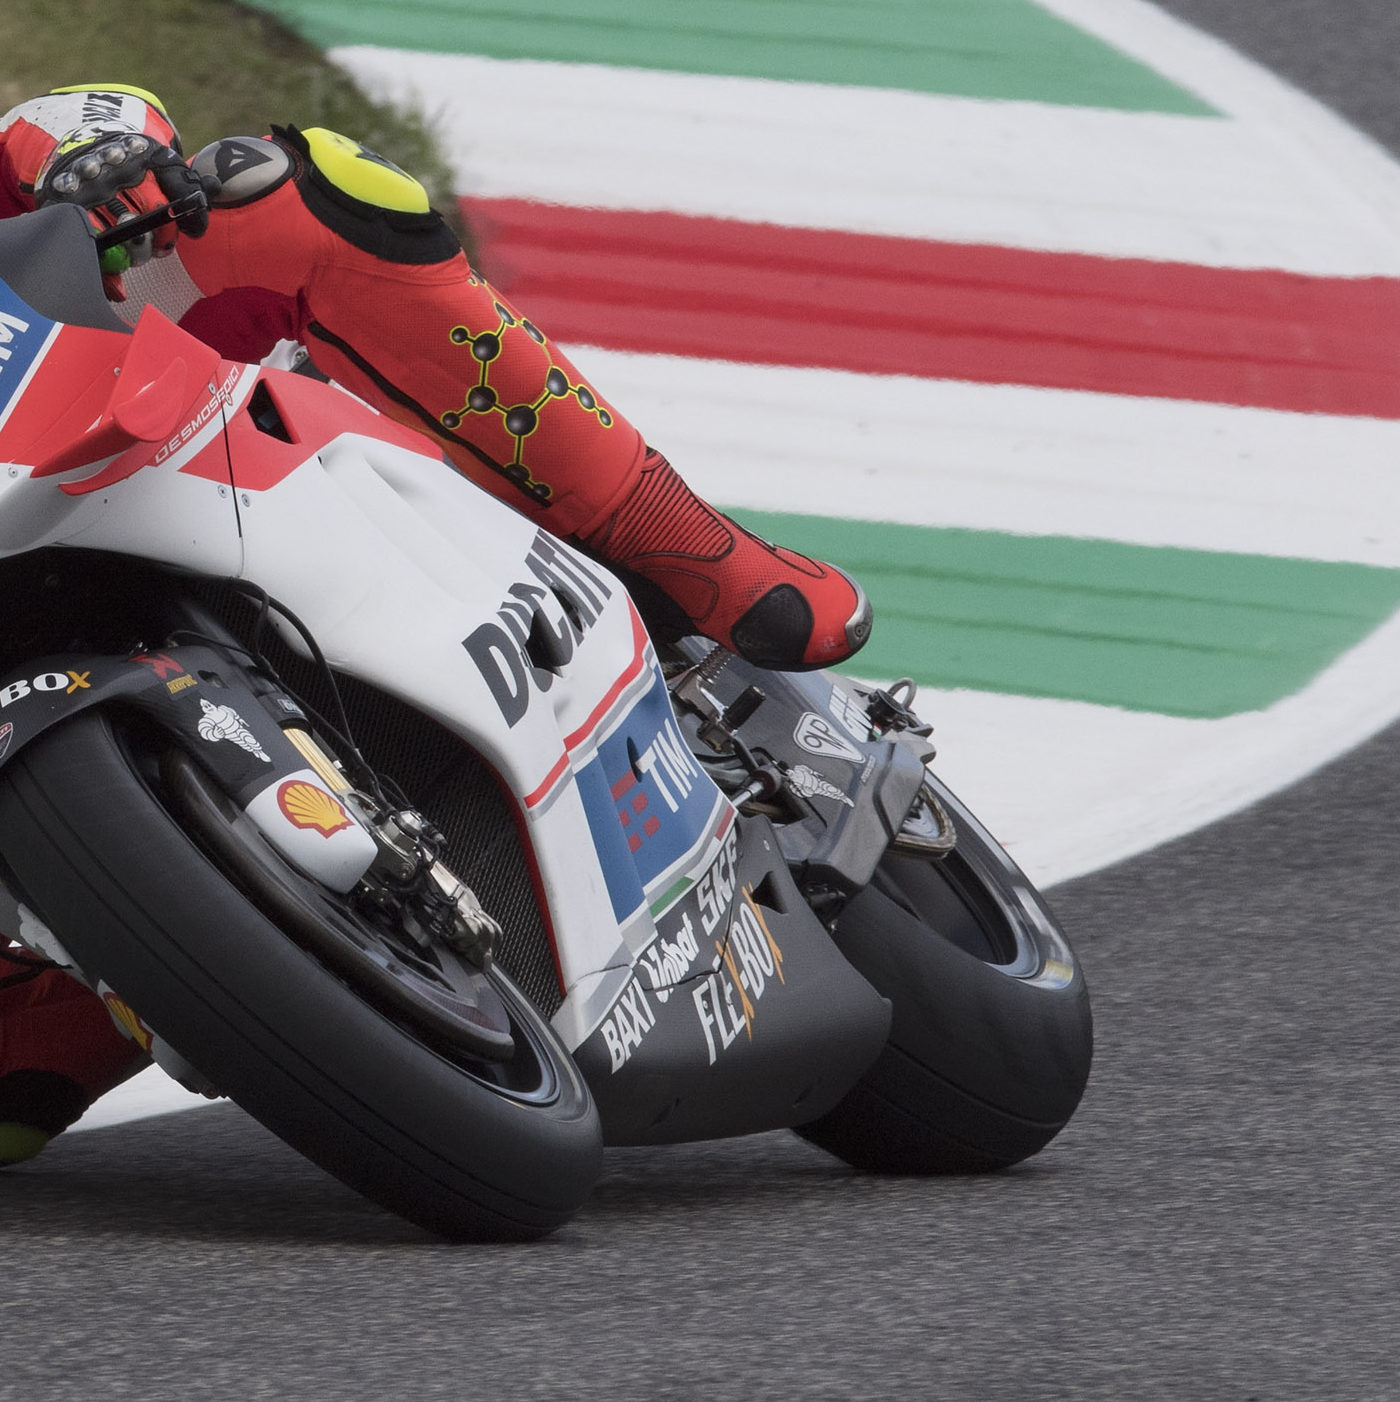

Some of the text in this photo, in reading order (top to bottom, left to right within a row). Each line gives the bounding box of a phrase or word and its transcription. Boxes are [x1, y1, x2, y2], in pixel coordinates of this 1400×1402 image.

[461, 527, 613, 730] DUCATI
[635, 717, 698, 813] TIM
[697, 825, 739, 937] SKF
[601, 976, 657, 1076] BAXI
[692, 881, 786, 1067] FLEX-BOX
